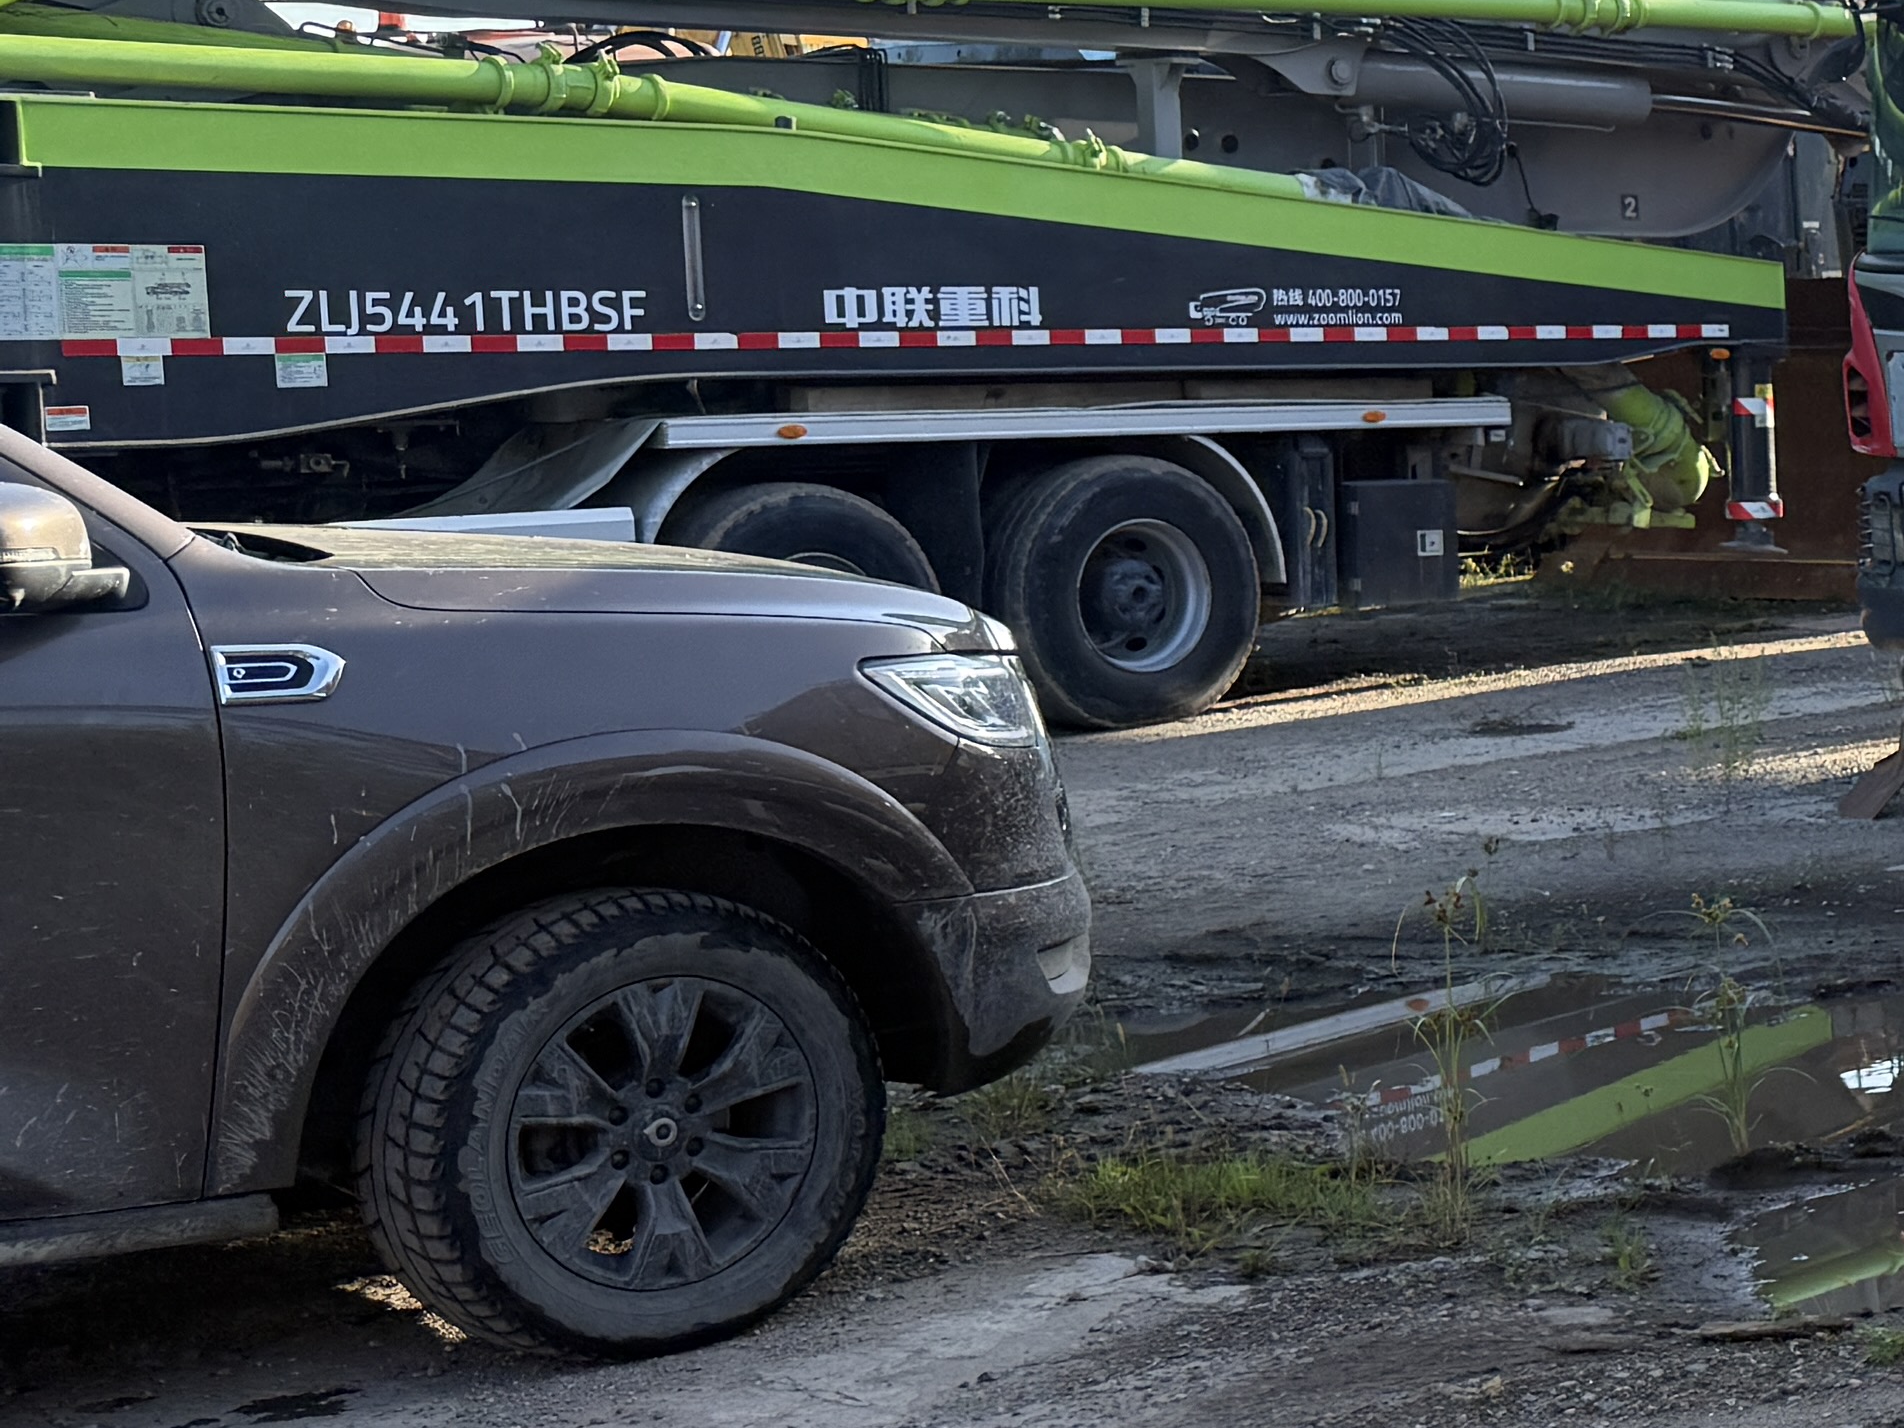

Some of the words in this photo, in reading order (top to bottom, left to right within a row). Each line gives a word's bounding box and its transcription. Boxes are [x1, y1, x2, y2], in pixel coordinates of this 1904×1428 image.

[1624, 196, 1637, 218] 2
[823, 286, 1043, 329] 中联重科
[1307, 288, 1401, 307] 400-800-0157
[284, 290, 647, 336] ZLJ5441THBSF
[1273, 309, 1403, 325] www.zoomlion.com
